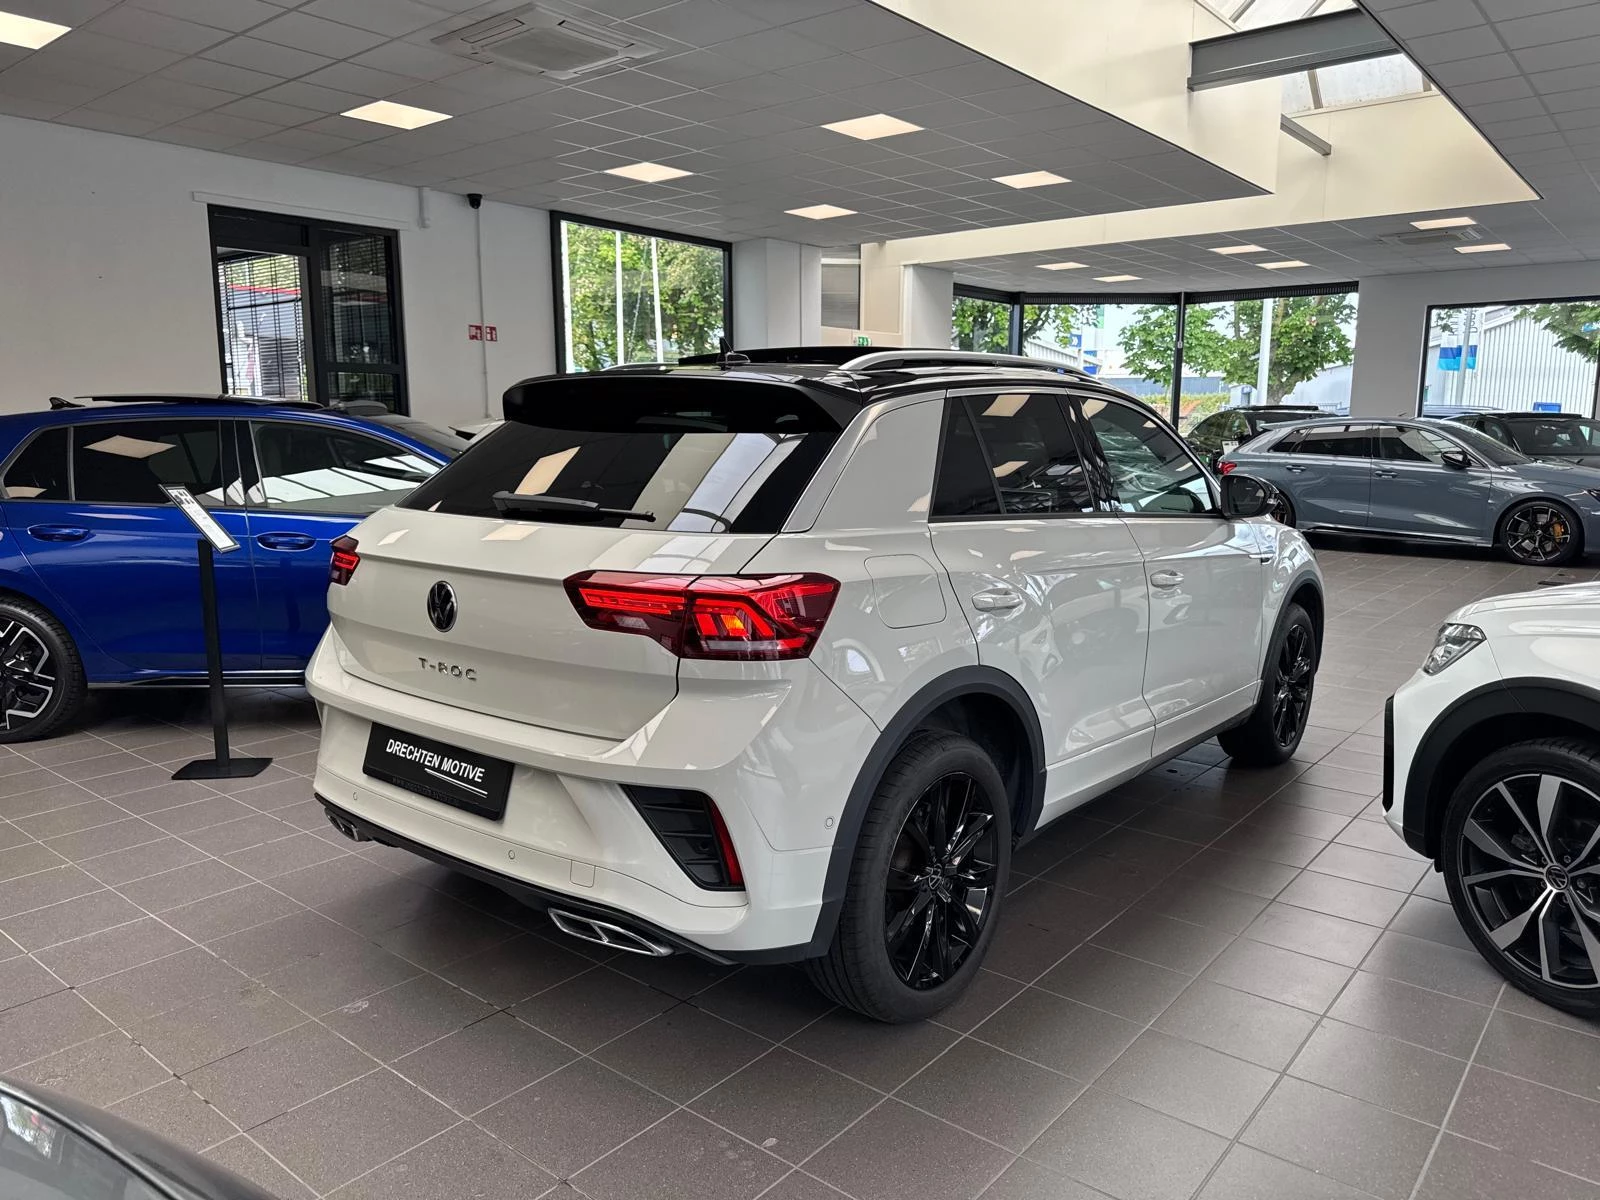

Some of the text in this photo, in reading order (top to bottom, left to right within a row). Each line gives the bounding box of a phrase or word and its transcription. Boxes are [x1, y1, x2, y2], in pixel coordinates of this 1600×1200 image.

[418, 657, 478, 681] T-ROC
[386, 739, 486, 783] DRECHTEN MOTIVE
